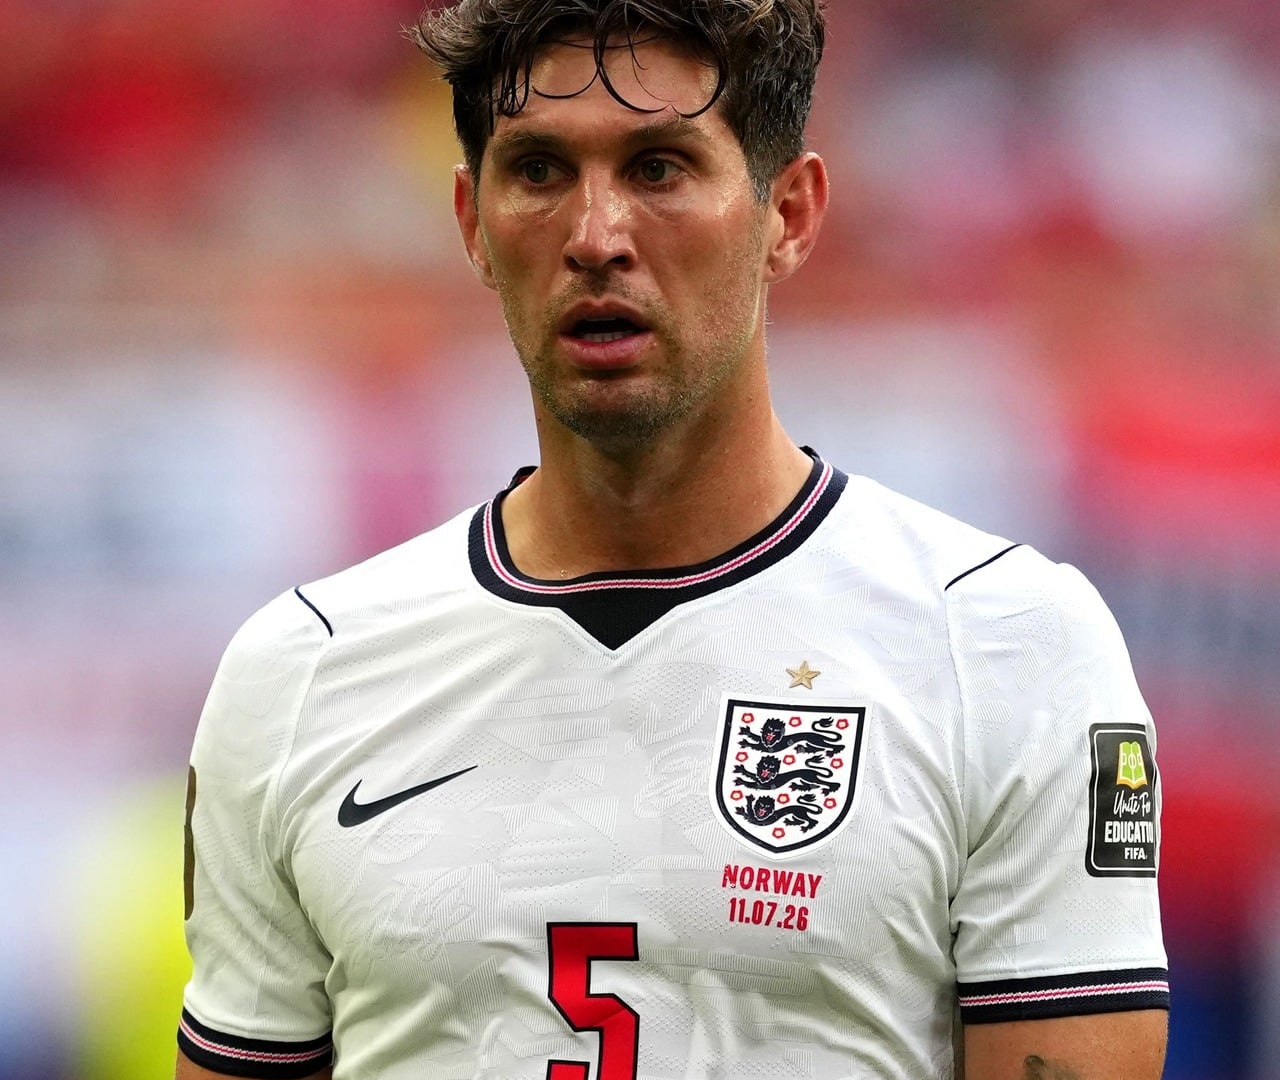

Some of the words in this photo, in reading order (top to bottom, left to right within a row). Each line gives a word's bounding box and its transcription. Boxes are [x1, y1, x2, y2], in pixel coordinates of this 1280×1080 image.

[1113, 790, 1140, 818] Unite
[1139, 792, 1151, 817] Fo
[1124, 847, 1146, 860] FIFA
[722, 864, 822, 898] NORWAY
[729, 898, 809, 931] 11.07.26
